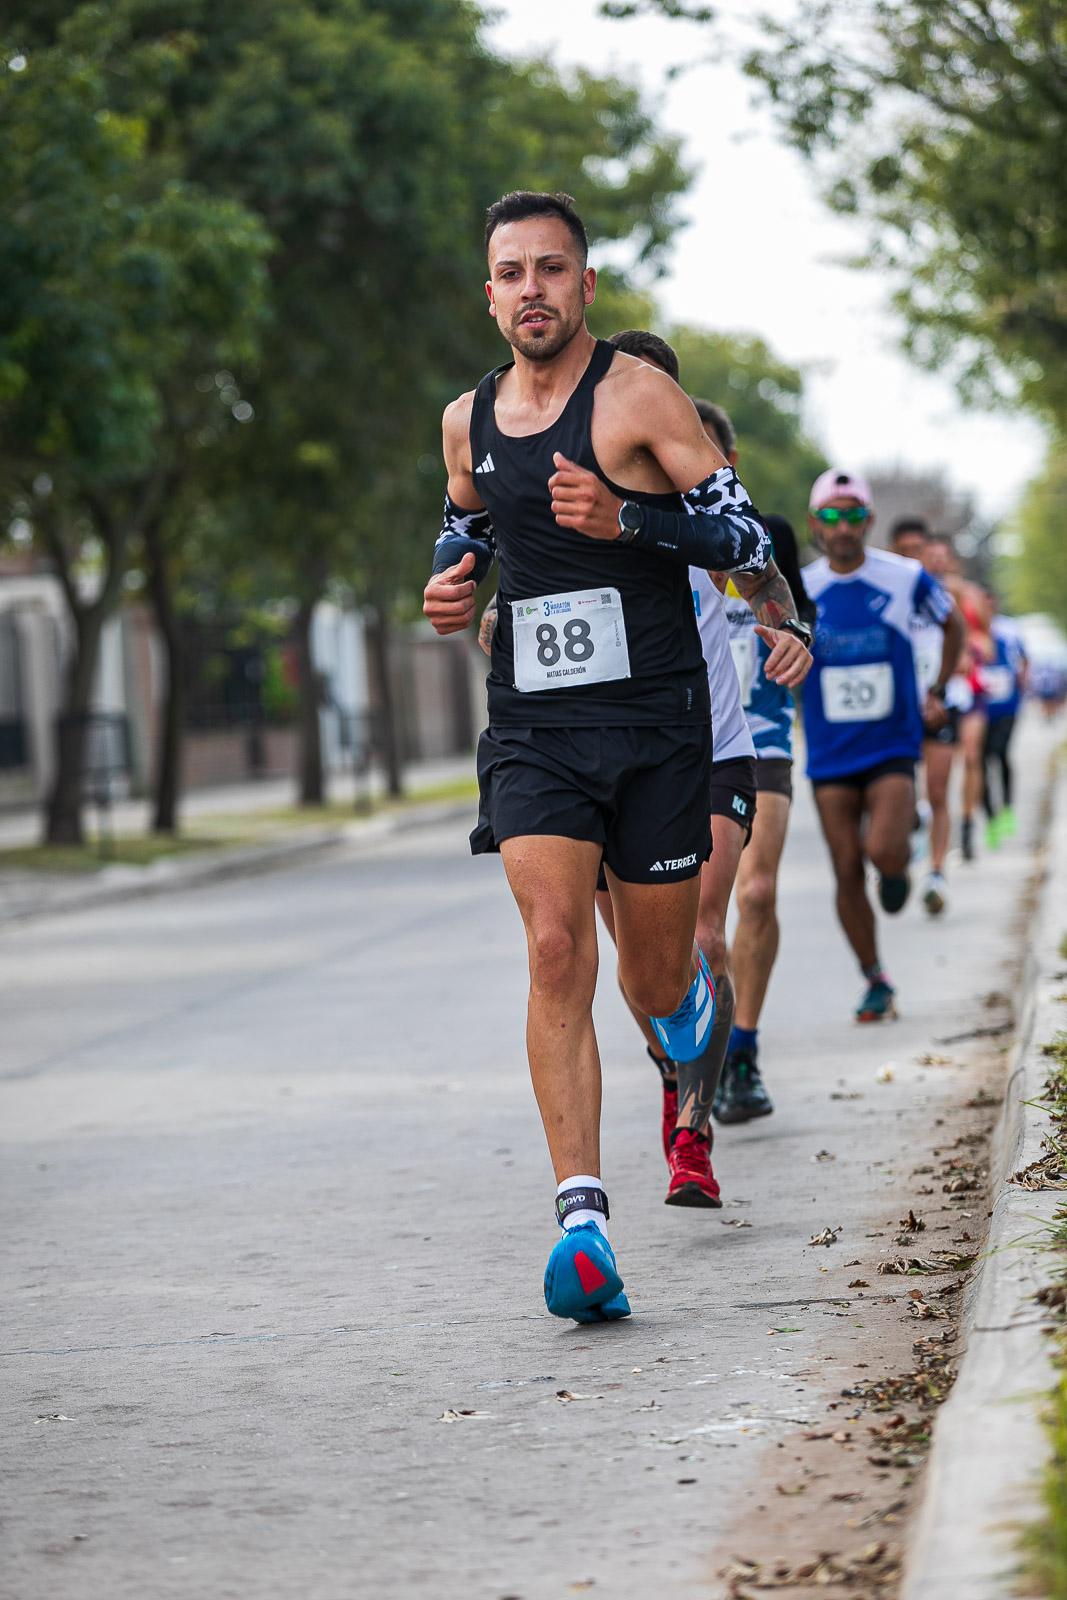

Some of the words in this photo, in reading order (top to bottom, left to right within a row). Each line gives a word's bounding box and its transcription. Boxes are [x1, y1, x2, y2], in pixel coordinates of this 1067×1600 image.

[543, 601, 550, 617] 3
[536, 618, 595, 667] 88
[546, 669, 562, 679] MATIAS
[562, 666, 587, 677] CALDERÓN
[838, 680, 876, 709] 20
[663, 852, 697, 871] TERREX
